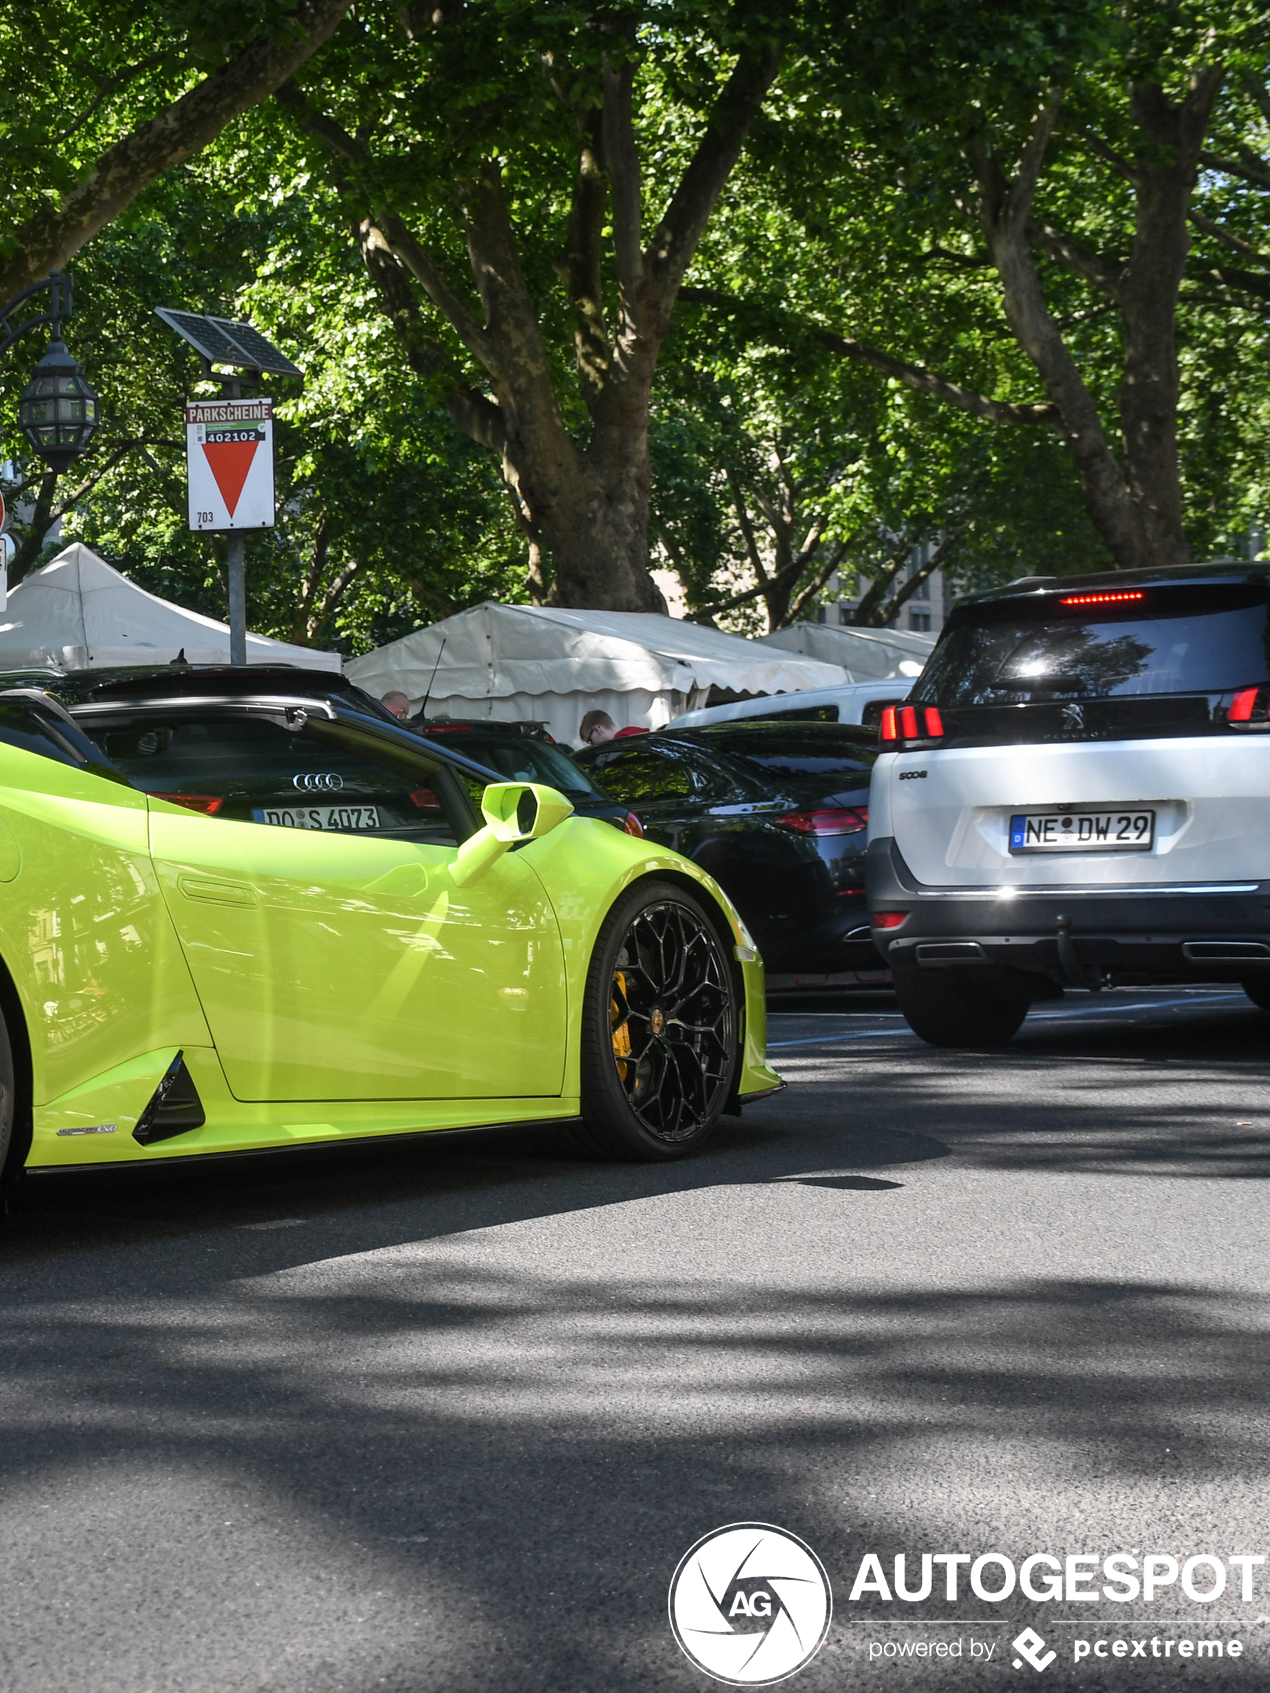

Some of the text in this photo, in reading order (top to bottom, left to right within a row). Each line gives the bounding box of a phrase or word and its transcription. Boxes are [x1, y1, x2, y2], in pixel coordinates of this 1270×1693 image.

[190, 405, 269, 422] PARKSCHEINE
[207, 431, 256, 442] 402102
[197, 511, 214, 523] 703
[1043, 731, 1108, 740] PEUGEOT
[898, 770, 928, 780] 5008
[309, 809, 322, 830] S
[327, 808, 376, 830] 4073
[1014, 815, 1149, 844] D NE DW 29
